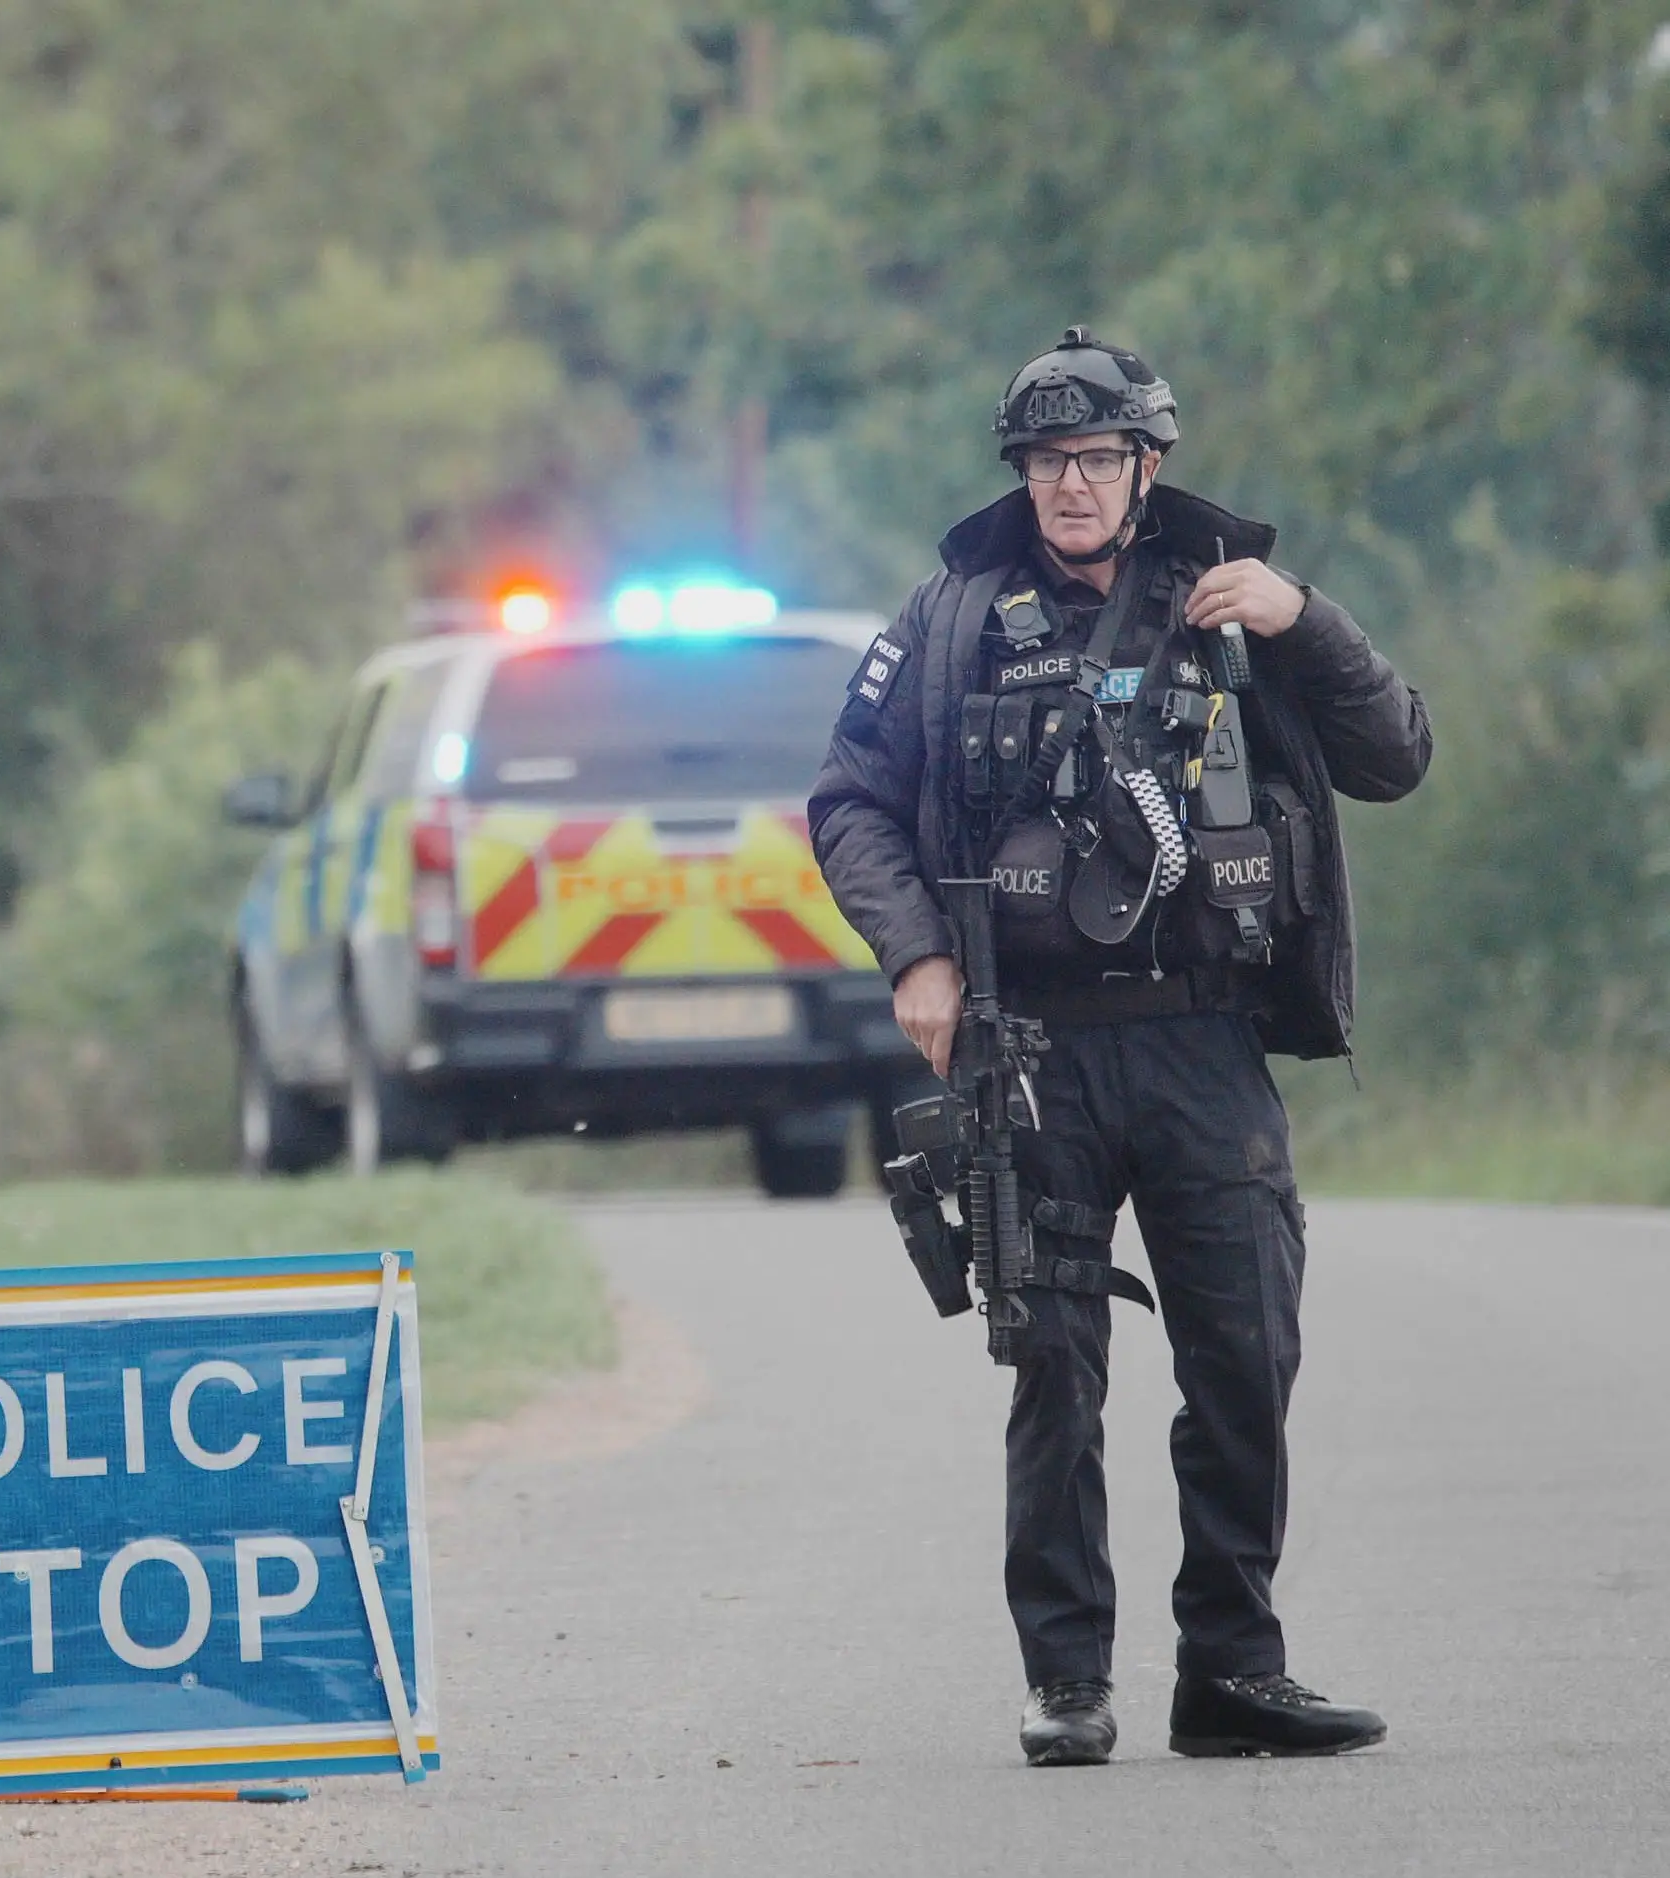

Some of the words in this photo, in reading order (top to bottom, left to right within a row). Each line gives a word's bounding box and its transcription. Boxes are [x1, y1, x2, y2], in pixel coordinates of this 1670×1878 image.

[873, 637, 904, 663] POLICE
[867, 658, 889, 683] MD
[1001, 657, 1072, 685] POLICE
[991, 867, 1051, 895] POLICE
[1212, 856, 1271, 887] POLICE
